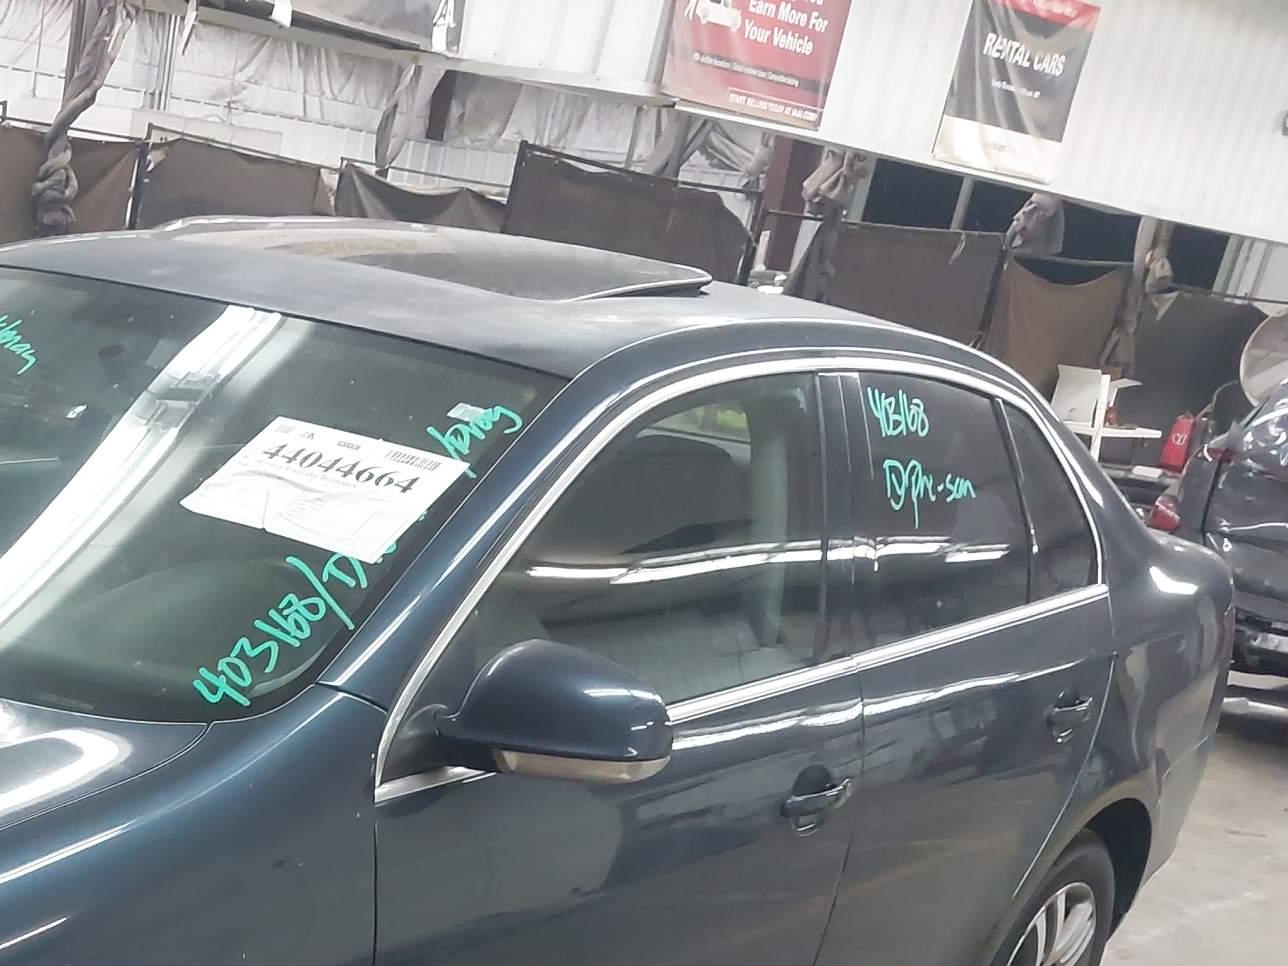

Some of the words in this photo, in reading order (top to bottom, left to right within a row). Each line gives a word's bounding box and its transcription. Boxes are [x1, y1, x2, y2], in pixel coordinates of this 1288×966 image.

[748, 0, 776, 18] Earn
[777, 8, 807, 27] More
[809, 12, 829, 33] For
[743, 19, 771, 44] Your
[772, 27, 813, 56] Vehicle
[983, 32, 1031, 68] RENTAL
[1033, 51, 1066, 77] CARS
[262, 443, 421, 494] 44044664
